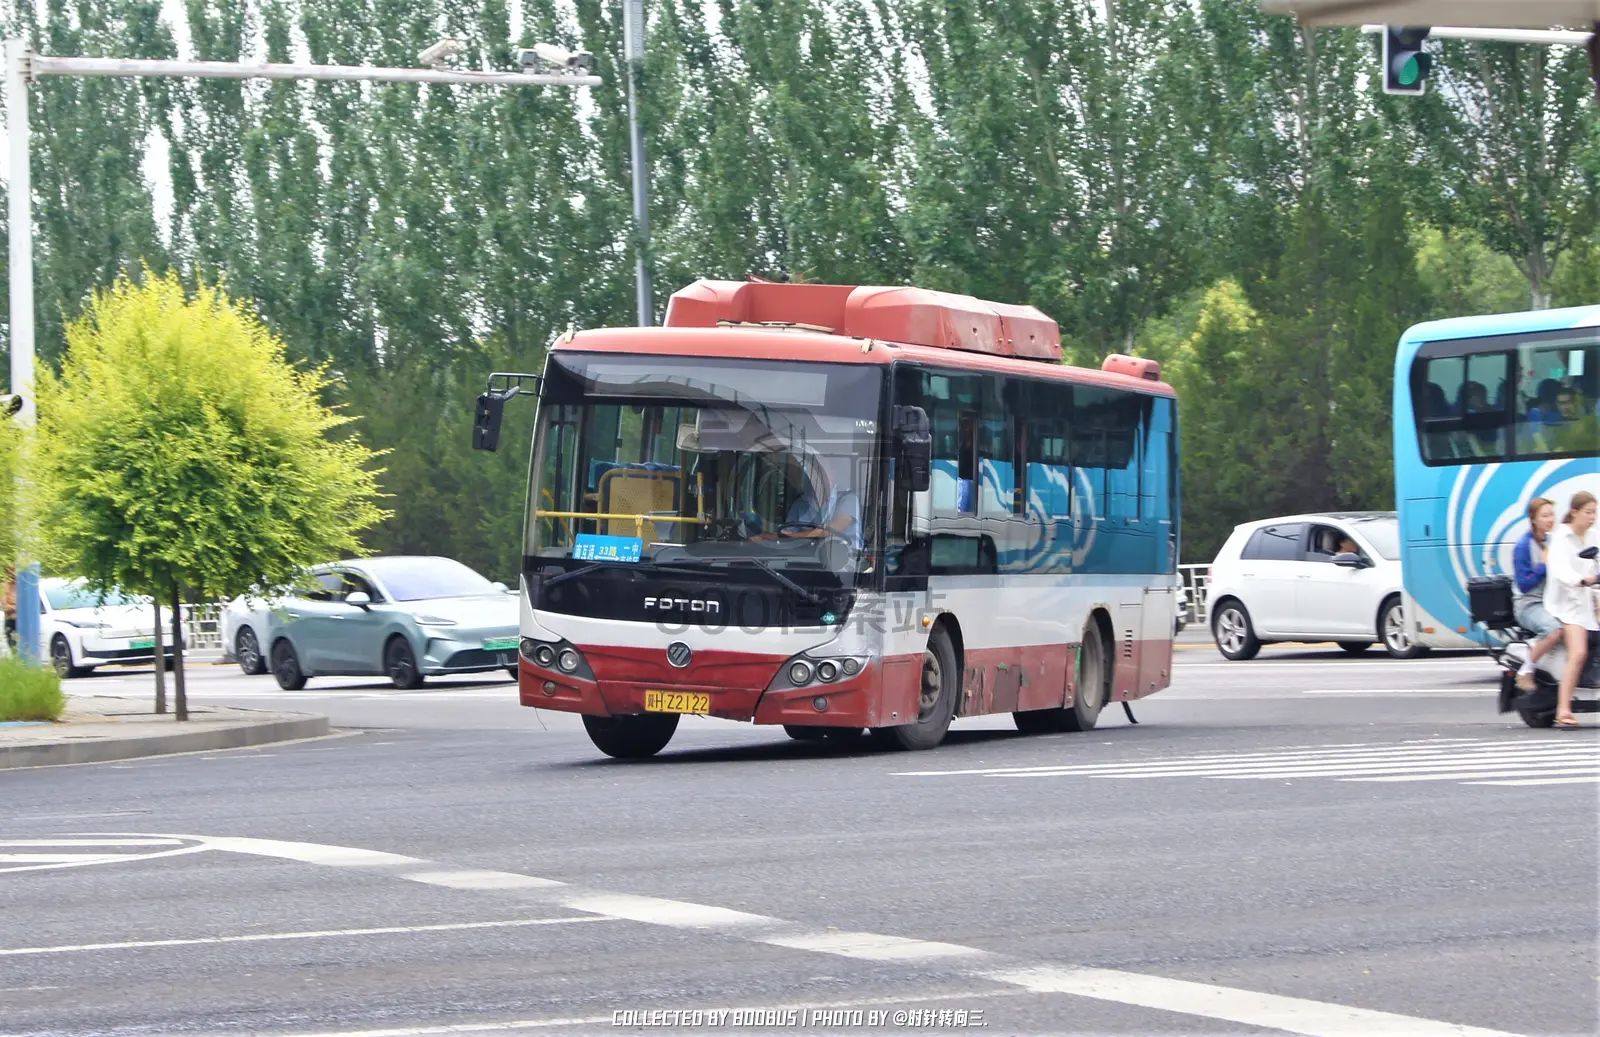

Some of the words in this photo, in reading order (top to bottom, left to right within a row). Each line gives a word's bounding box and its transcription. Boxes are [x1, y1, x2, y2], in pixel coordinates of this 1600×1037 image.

[599, 545, 617, 556] 33路
[644, 597, 720, 613] FOTON
[822, 614, 835, 622] CNG
